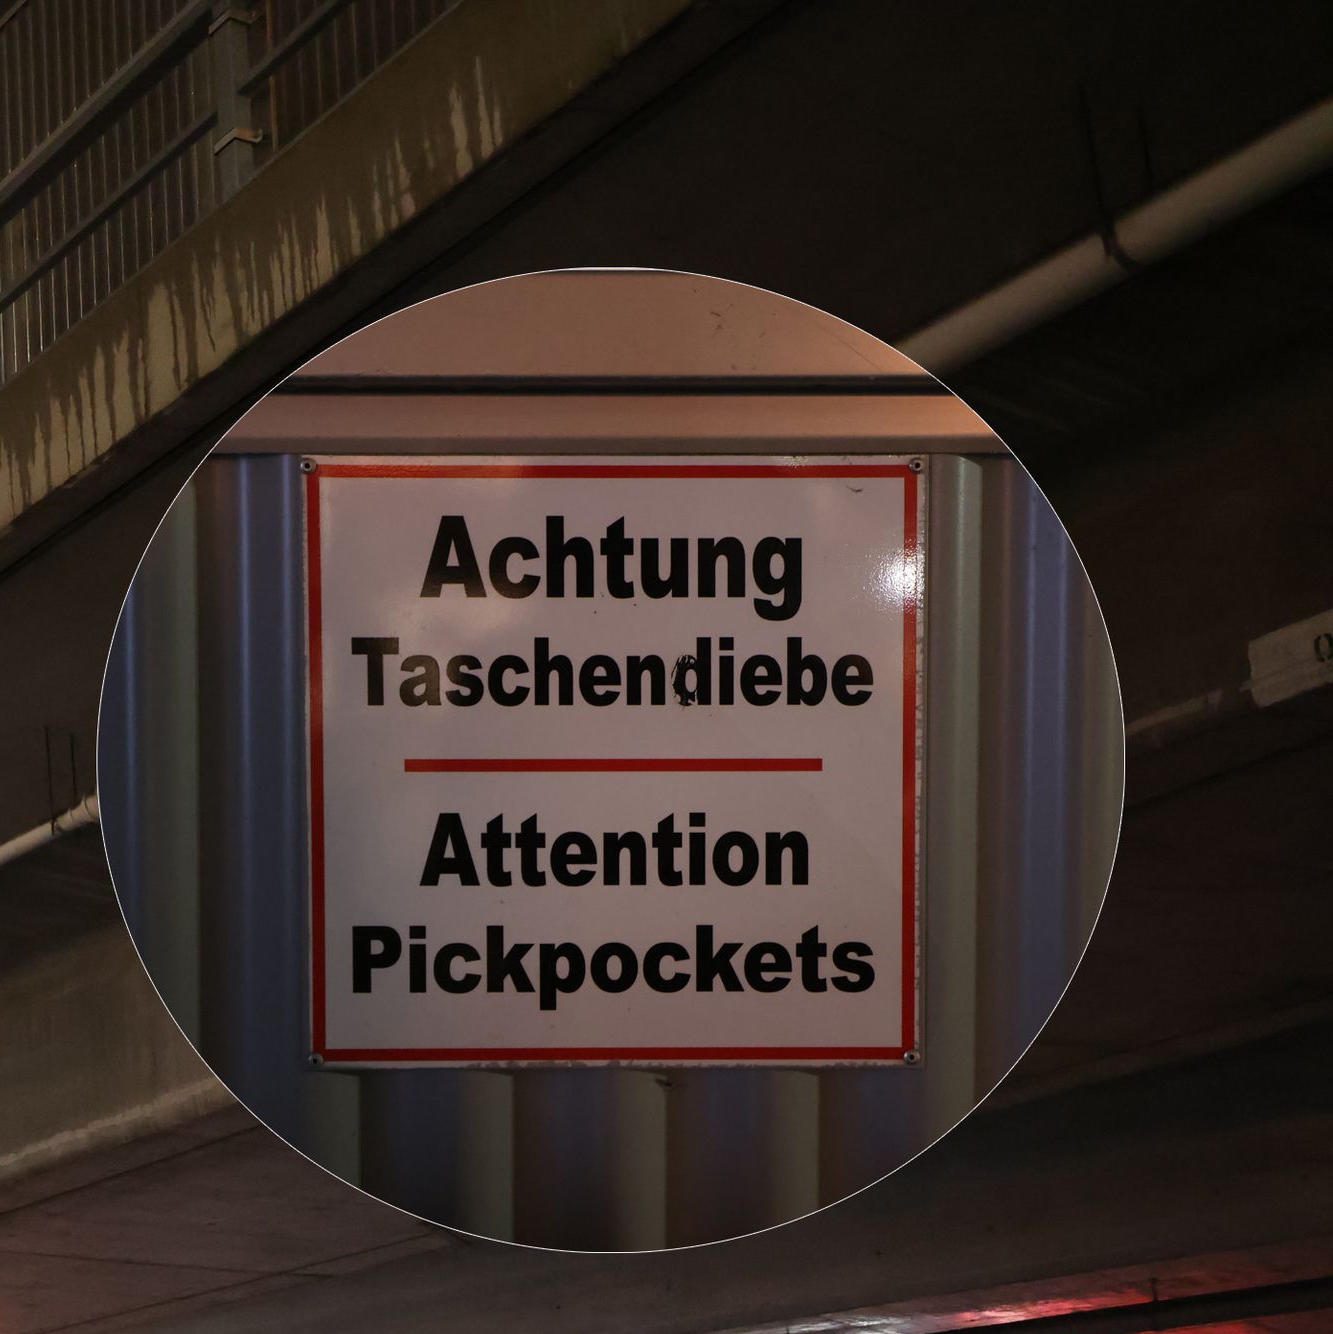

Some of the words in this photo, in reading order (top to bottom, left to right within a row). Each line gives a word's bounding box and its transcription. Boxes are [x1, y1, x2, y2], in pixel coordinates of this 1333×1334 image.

[420, 515, 803, 621] Achtung
[351, 637, 874, 707] Taschendiebe
[419, 812, 809, 886] Attention
[351, 925, 876, 1011] Pickpockets
